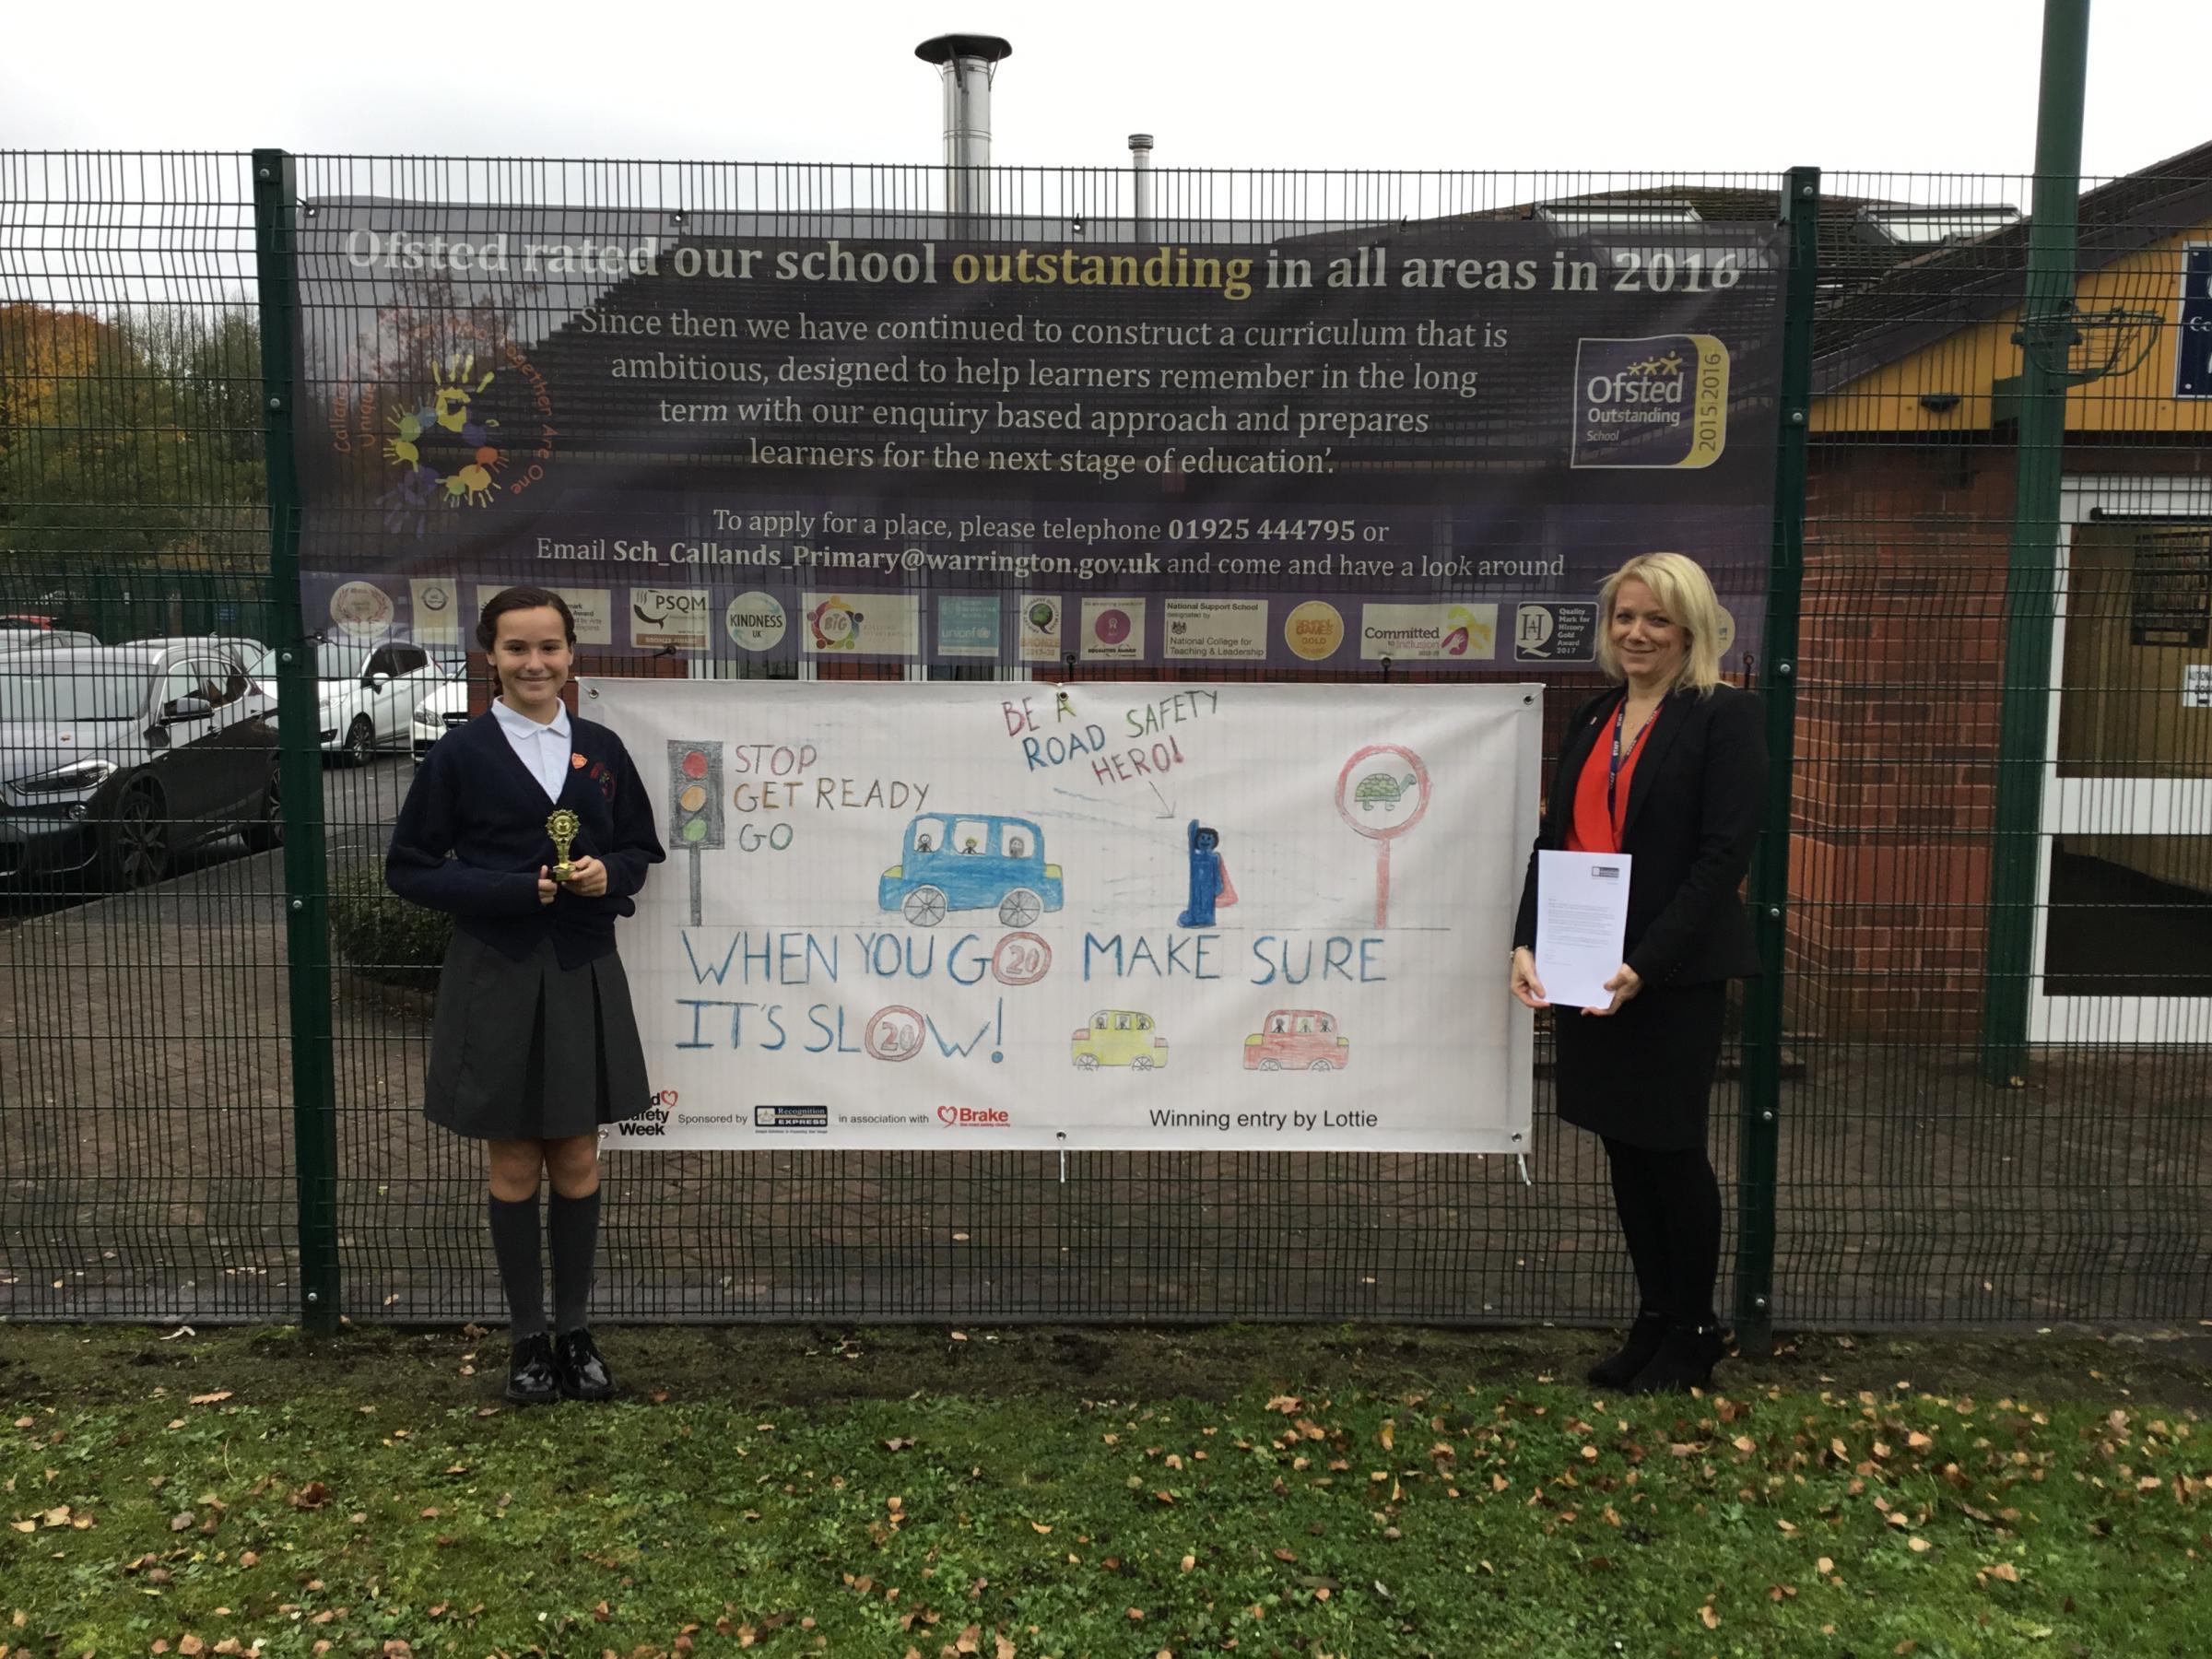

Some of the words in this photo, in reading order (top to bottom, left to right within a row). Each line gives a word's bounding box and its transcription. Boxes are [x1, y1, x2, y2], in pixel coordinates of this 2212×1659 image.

[346, 228, 509, 272] Ofsted
[524, 236, 657, 276] rated
[675, 245, 762, 278] our
[775, 240, 936, 284] school
[952, 247, 1253, 300] outstanding
[1266, 250, 1313, 288] in
[1329, 247, 1387, 288] all
[1402, 258, 1537, 290] areas
[1552, 251, 1598, 291] in
[1614, 253, 1740, 292] 2016
[582, 307, 661, 335] Since
[670, 309, 737, 337] then
[747, 318, 790, 338] we
[799, 311, 868, 340] have
[877, 314, 1024, 343] continued
[1034, 319, 1062, 344] to
[1071, 322, 1213, 346] construct
[1219, 329, 1235, 346] a
[1245, 319, 1406, 347] curriculum
[1417, 322, 1477, 347] that
[1484, 323, 1508, 347] is
[611, 354, 770, 385] ambitious,
[778, 356, 909, 387] designed
[919, 360, 947, 383] to
[956, 357, 1020, 392] help
[1029, 359, 1151, 388] learners
[1160, 363, 1314, 389] remember
[1322, 363, 1348, 388] in
[1359, 364, 1406, 389] the
[1414, 364, 1477, 397] long
[1587, 371, 1685, 404] Ofsted
[659, 401, 728, 422] term
[738, 396, 802, 423] with
[811, 404, 865, 425] our
[874, 404, 989, 434] enquiry
[997, 402, 1082, 429] based
[1090, 406, 1229, 438] approach
[1236, 406, 1289, 432] and
[1299, 412, 1430, 439] prepares
[1588, 407, 1681, 427] Outstanding
[1586, 429, 1619, 441] School
[749, 439, 874, 467] learners
[882, 443, 925, 469] for
[933, 444, 980, 470] the
[988, 451, 1053, 472] next
[1060, 451, 1136, 480] stage
[1145, 448, 1176, 474] of
[510, 464, 544, 495] One
[713, 509, 741, 532] To
[748, 510, 813, 538] apply
[822, 511, 857, 535] for
[865, 521, 876, 535] a
[884, 514, 953, 542] place,
[959, 516, 1036, 545] please
[1043, 518, 1161, 546] telephone
[1168, 519, 1250, 541] 01925
[1256, 520, 1356, 542] 444795
[1363, 526, 1389, 542] or
[536, 537, 606, 562] Email
[1167, 552, 1211, 574] and
[1218, 558, 1283, 575] come
[1288, 553, 1332, 576] and
[1339, 554, 1394, 576] have
[1401, 561, 1415, 576] a
[1420, 555, 1473, 577] look
[1478, 555, 1565, 577] around
[655, 595, 707, 614] PSQM
[1200, 603, 1230, 612] Support
[730, 614, 782, 629] KINDNESS
[752, 630, 762, 639] UK
[1364, 627, 1440, 639] Committed
[1170, 647, 1207, 656] Teaching
[1218, 647, 1264, 657] Leadership
[1171, 637, 1204, 645] National
[1206, 638, 1239, 647] College
[1001, 697, 1041, 737] BE
[1022, 724, 1107, 772] ROAD
[1126, 689, 1218, 738] SAFETY
[735, 743, 818, 776] STOP
[1091, 735, 1184, 786] HERO!
[734, 781, 805, 813] GET
[817, 777, 930, 813] READY
[739, 822, 794, 853] GO
[681, 930, 839, 985] WHEN
[855, 932, 935, 979] YOU
[1084, 932, 1221, 982] MAKE
[1250, 935, 1387, 984] SURE
[676, 999, 787, 1051] IT'S
[629, 1109, 670, 1124] afety
[678, 1114, 733, 1125] Sponsored
[736, 1114, 747, 1125] by
[778, 1107, 825, 1115] Recognition
[839, 1114, 847, 1124] in
[850, 1114, 906, 1124] association
[910, 1113, 929, 1124] with
[959, 1107, 1009, 1122] Brake
[1149, 1109, 1230, 1131] Winning
[1237, 1110, 1287, 1131] entry
[1294, 1109, 1317, 1131] by
[1324, 1109, 1379, 1127] Lottie
[619, 1123, 665, 1136] Week
